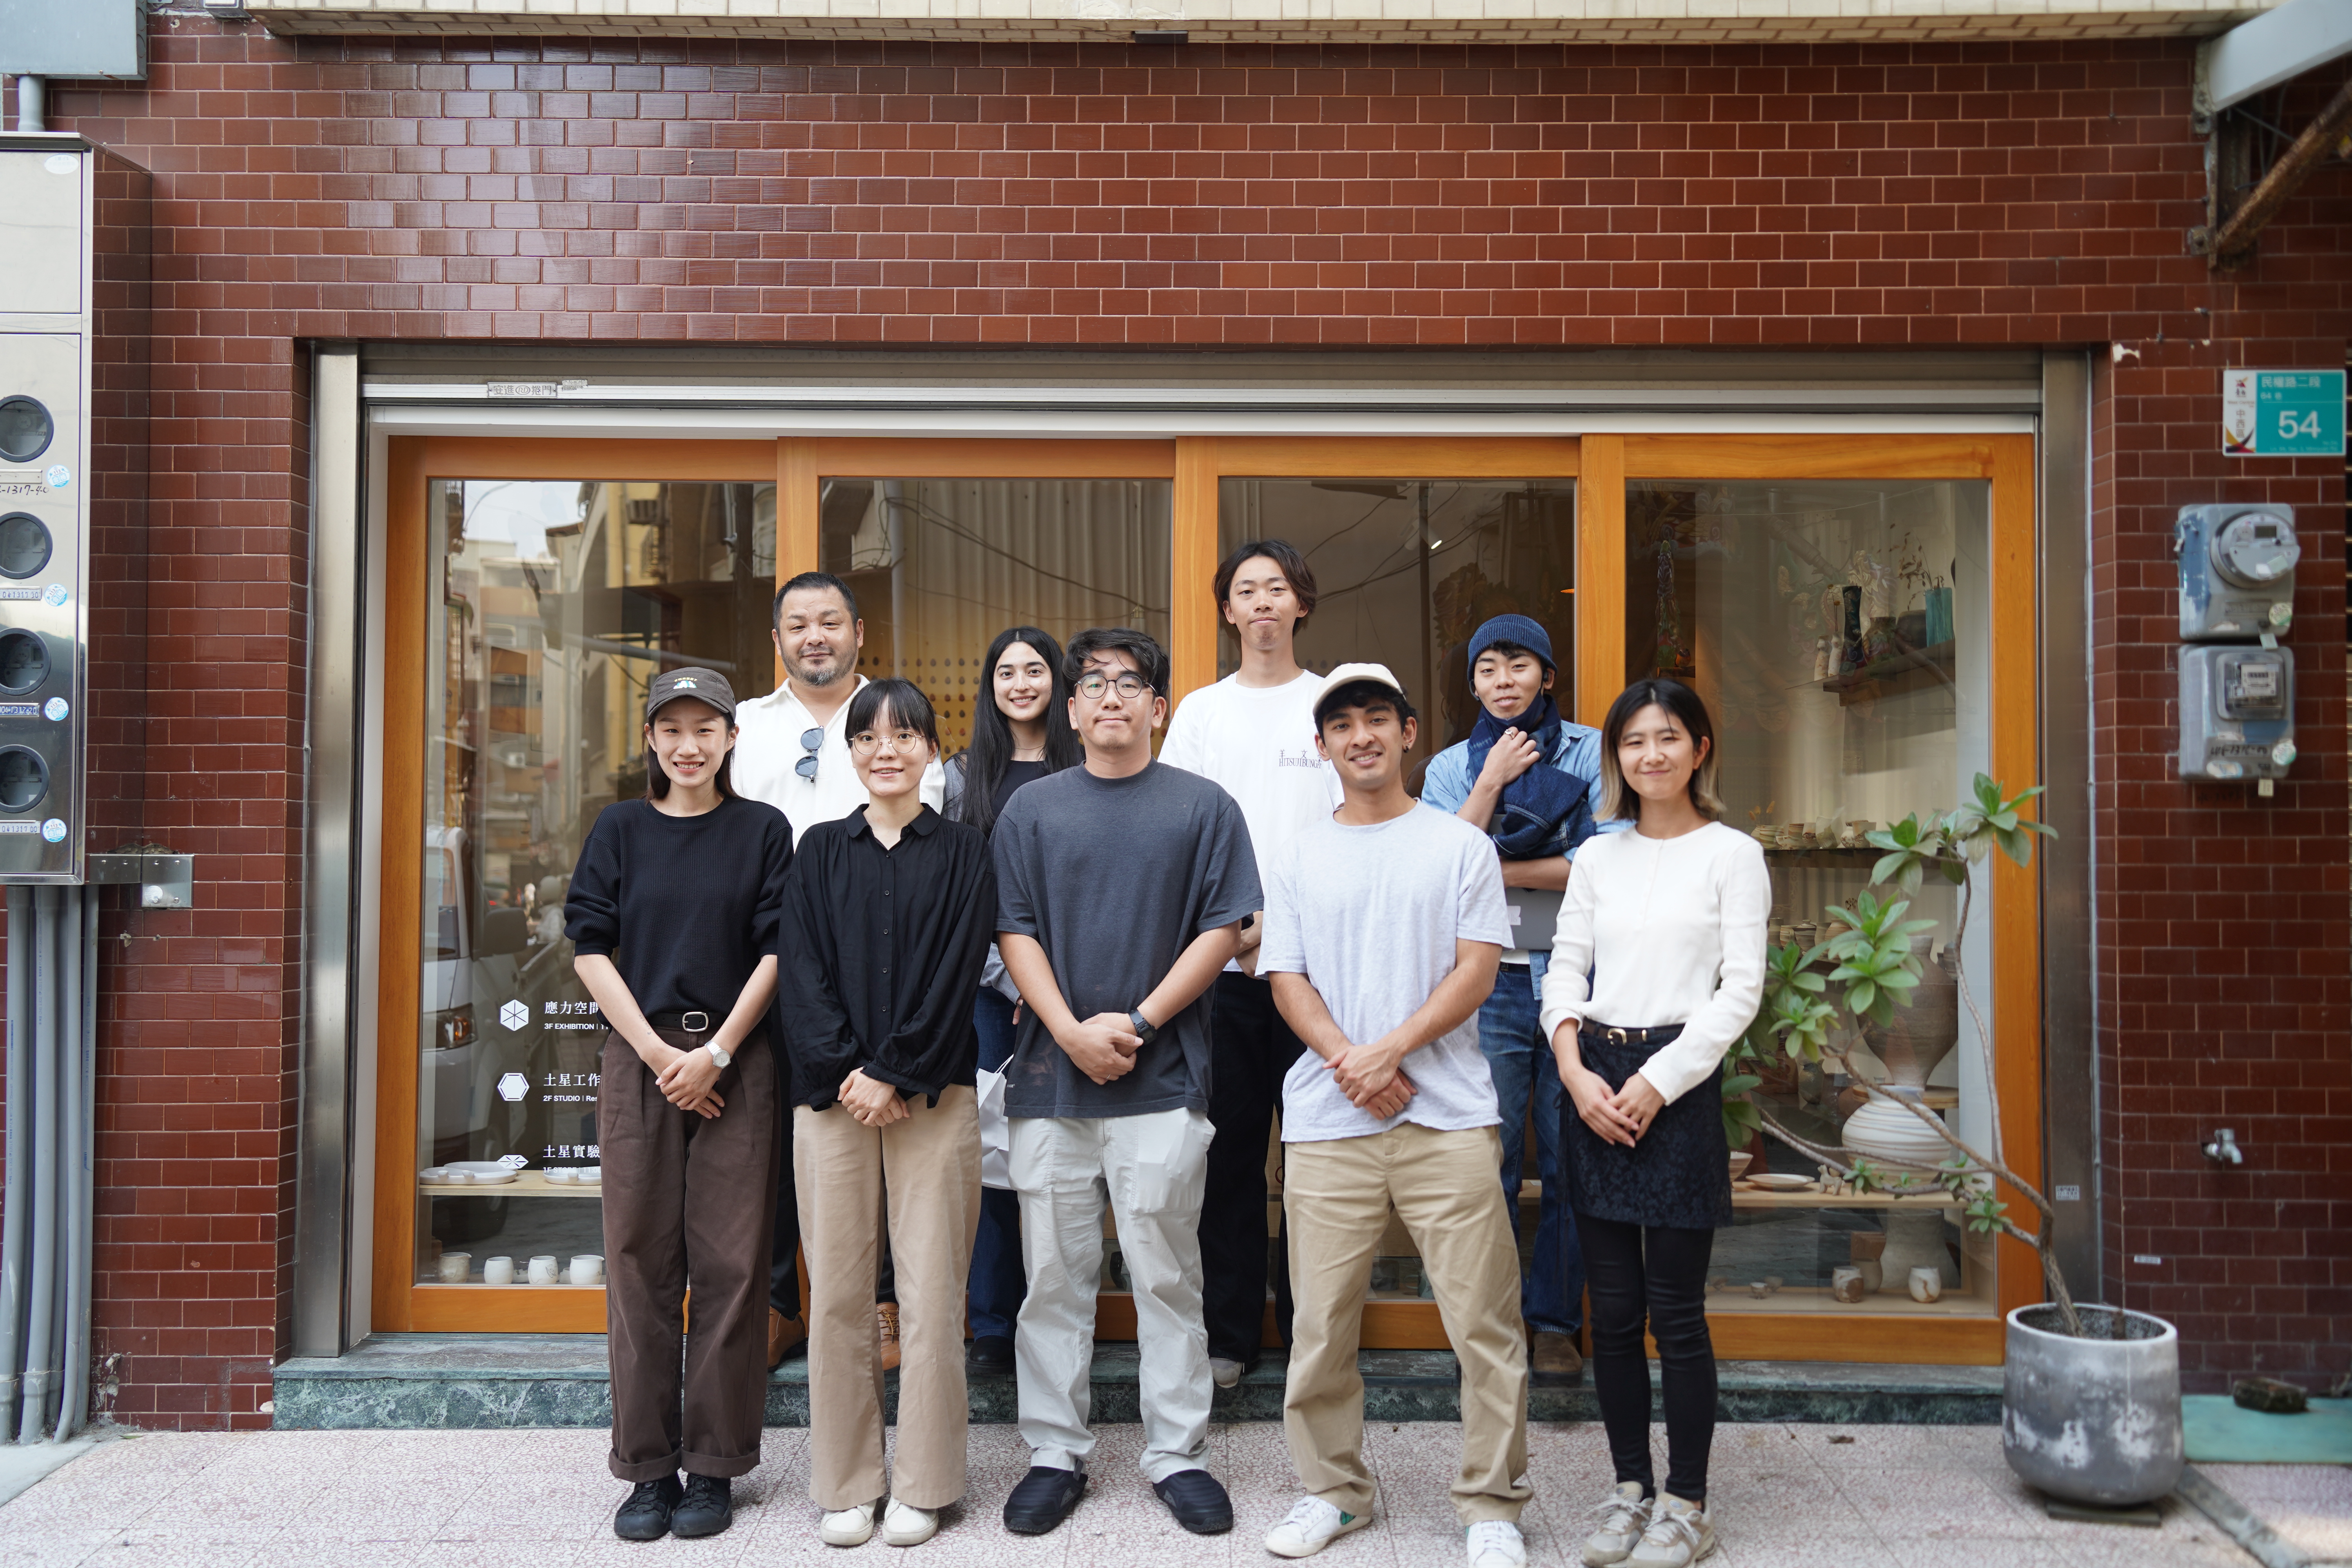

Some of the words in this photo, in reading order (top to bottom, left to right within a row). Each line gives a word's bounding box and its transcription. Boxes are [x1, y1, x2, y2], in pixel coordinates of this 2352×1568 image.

[2261, 376, 2321, 388] 民權路二段
[494, 385, 514, 395] 安進
[532, 385, 552, 395] 捲門
[2236, 409, 2245, 438] 中西區
[2278, 410, 2321, 439] 54
[544, 1073, 601, 1087] 土星工作
[543, 1144, 600, 1158] 土星實驗
